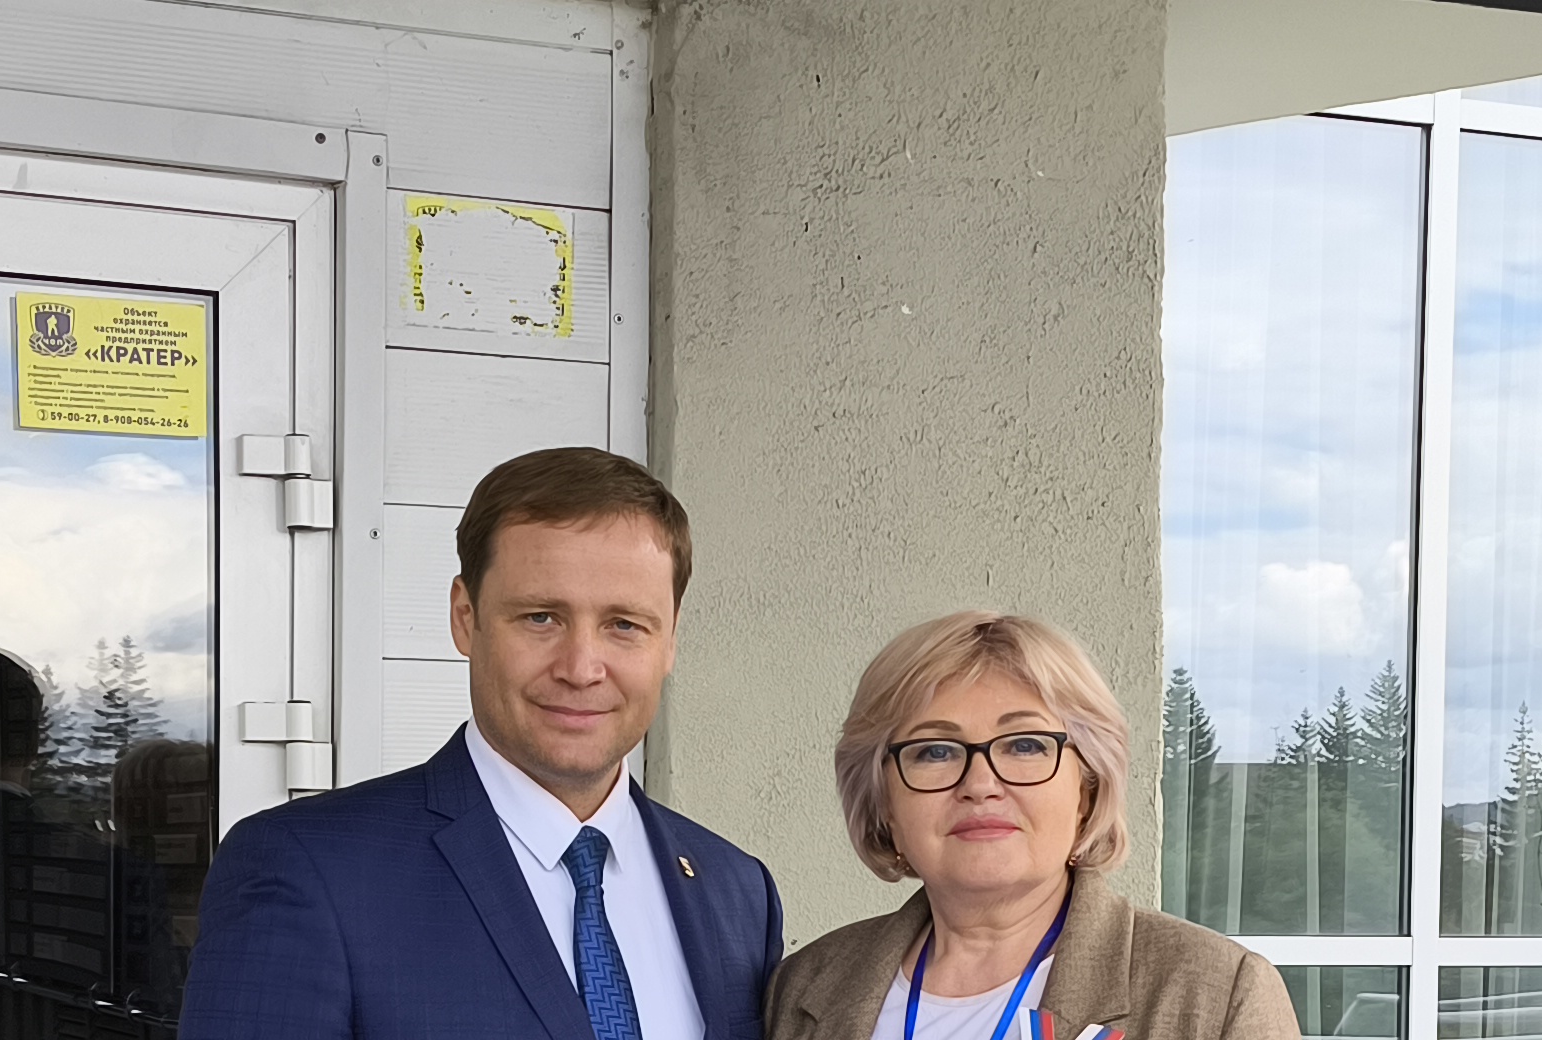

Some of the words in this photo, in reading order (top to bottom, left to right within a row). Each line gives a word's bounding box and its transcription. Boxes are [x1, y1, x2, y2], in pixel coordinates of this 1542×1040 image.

[123, 307, 158, 318] Объект
[112, 317, 169, 328] охраняется
[93, 325, 136, 335] частным
[138, 328, 188, 338] охранным
[105, 335, 177, 347] предприятием
